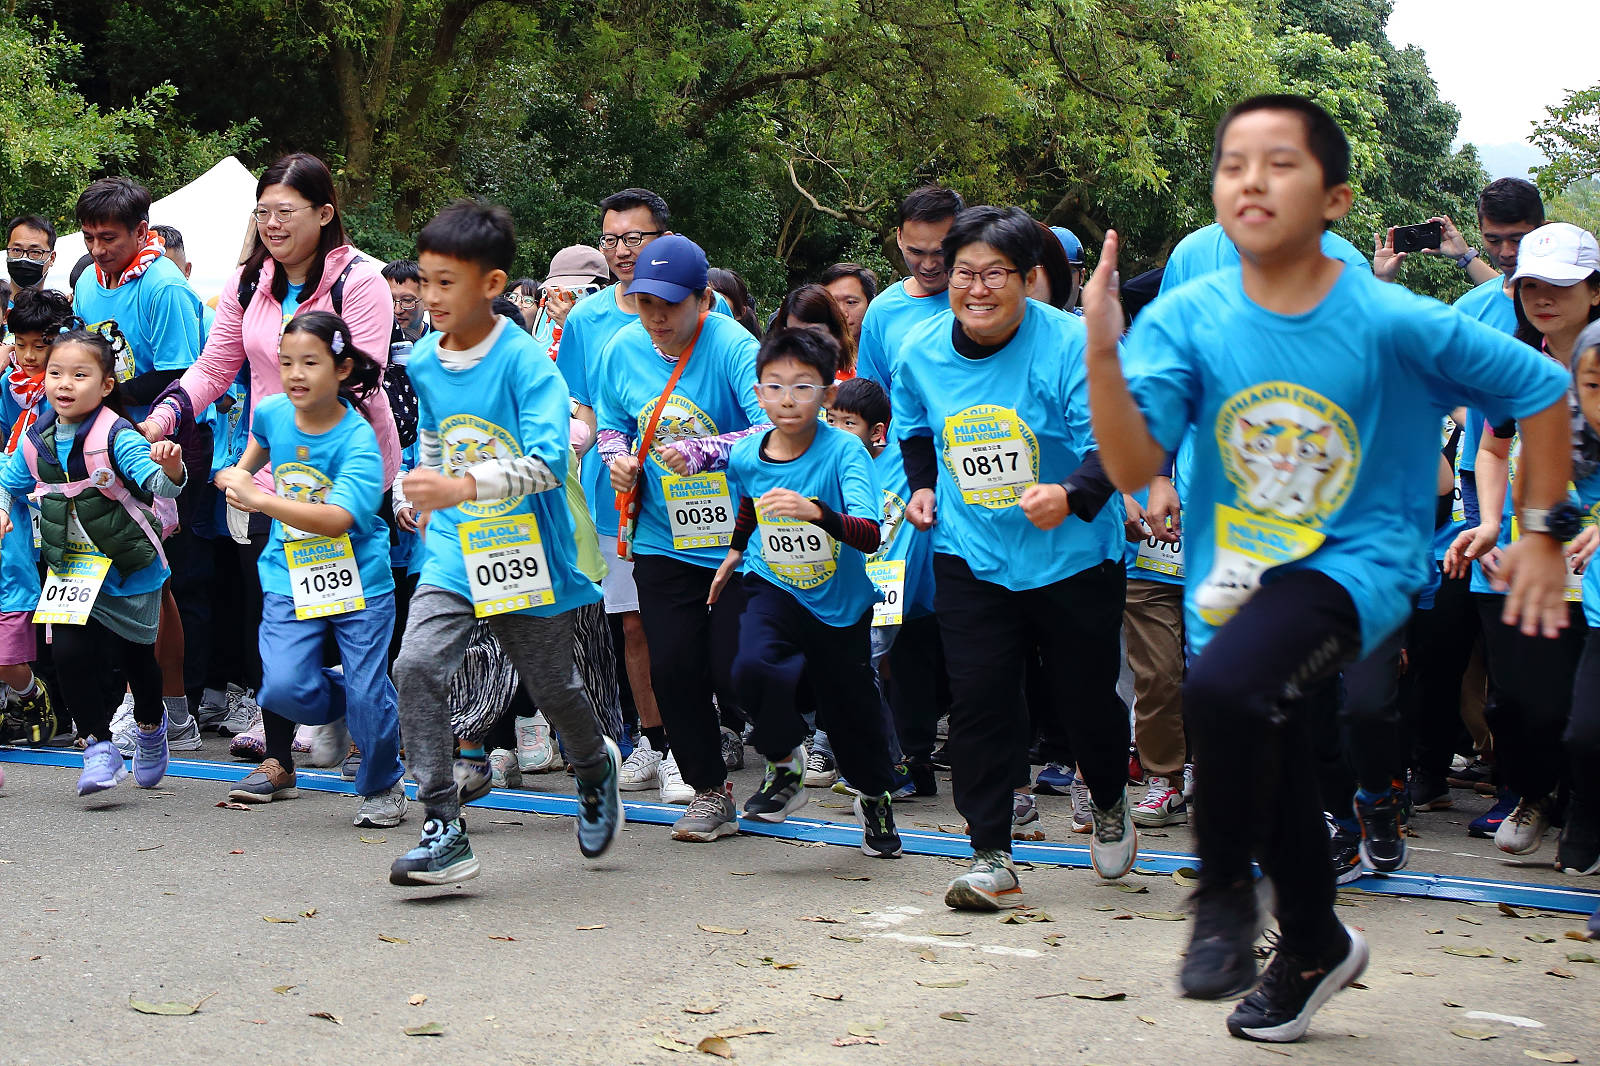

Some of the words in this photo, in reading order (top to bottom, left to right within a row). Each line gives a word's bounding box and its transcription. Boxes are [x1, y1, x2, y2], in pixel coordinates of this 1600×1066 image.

[675, 398, 691, 410] FUN
[692, 408, 716, 435] YOUNG
[953, 422, 1000, 435] MIAOLI
[955, 435, 976, 443] FUN
[977, 430, 1011, 440] YOUNG
[963, 451, 1019, 476] 0817
[669, 481, 711, 491] MIAOLI
[691, 488, 721, 496] YOUNG
[675, 506, 728, 525] 0038
[468, 525, 519, 540] MIAOLI
[292, 543, 335, 558] MIAOLI
[470, 540, 493, 550] FUN
[768, 535, 821, 552] 0819
[294, 556, 312, 565] FUN
[314, 550, 345, 561] YOUNG
[477, 556, 538, 586] 0039
[867, 568, 891, 576] IAOLI
[300, 569, 353, 594] 1039
[46, 585, 92, 602] 0136
